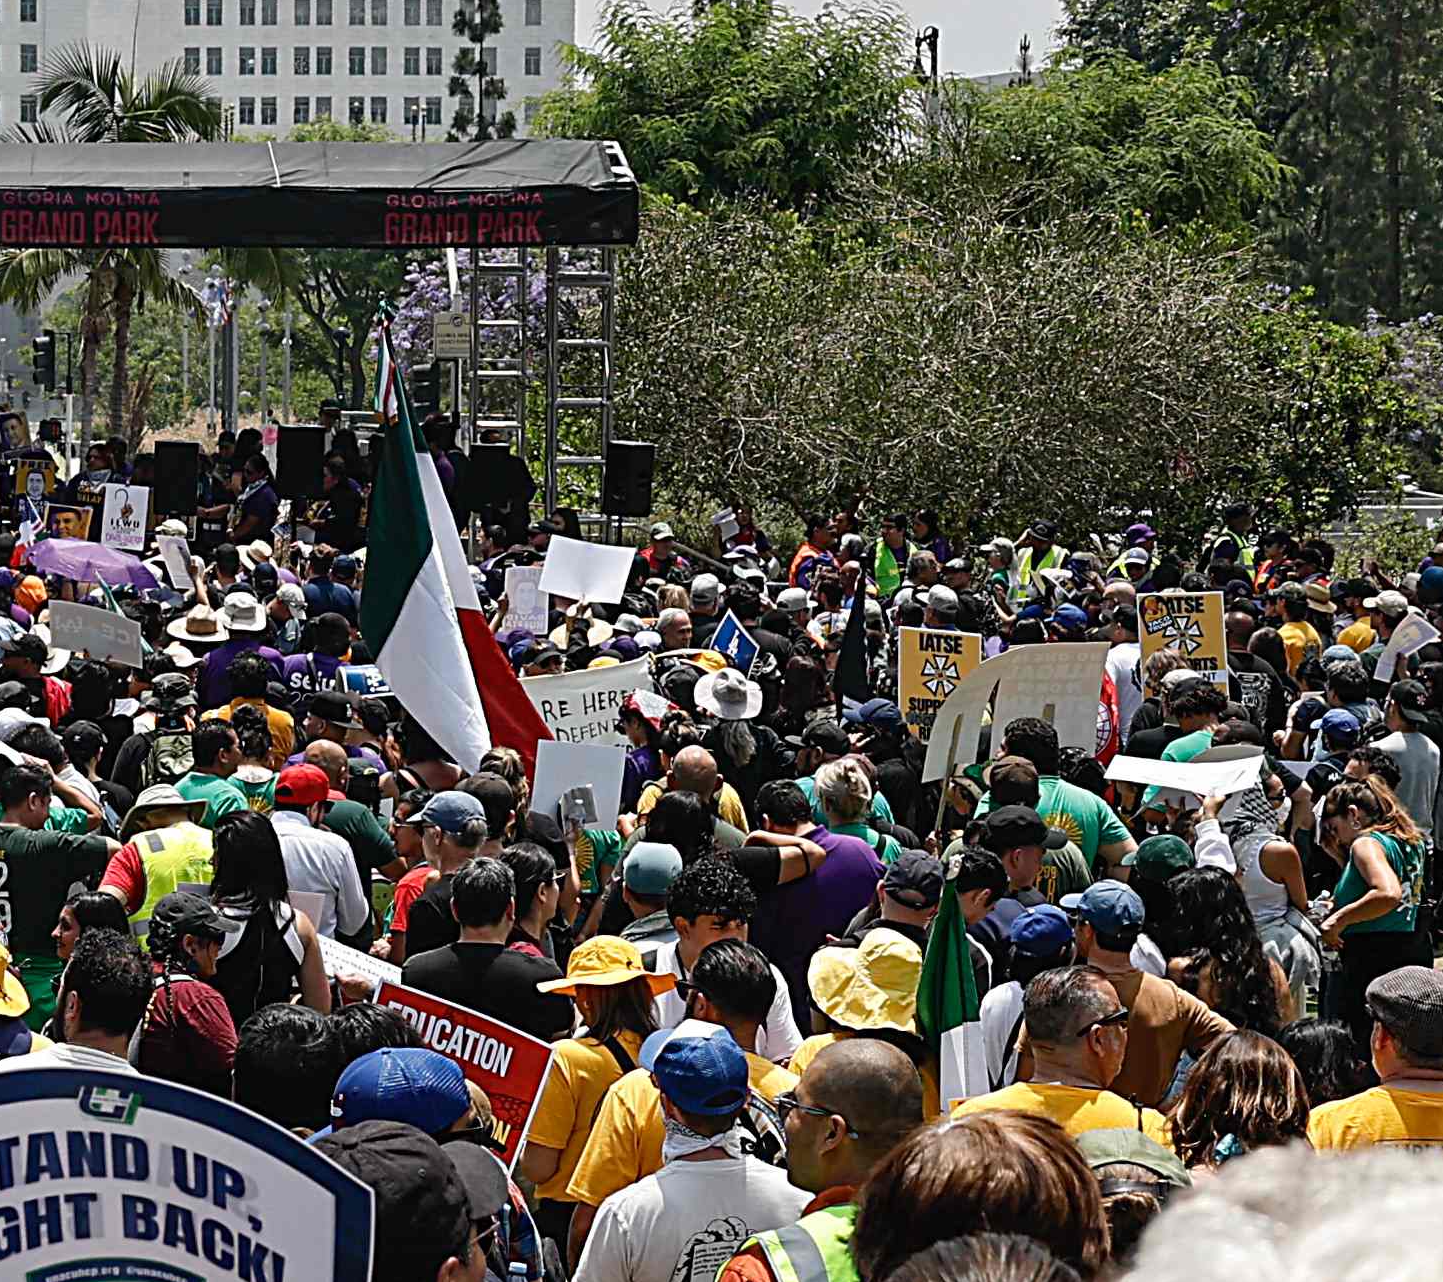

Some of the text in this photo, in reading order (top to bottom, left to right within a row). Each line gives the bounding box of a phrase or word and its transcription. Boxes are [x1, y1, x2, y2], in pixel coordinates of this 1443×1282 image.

[3, 192, 160, 205] GLORIA MOLINA
[386, 192, 544, 208] GLORIA MOLINA
[1, 210, 160, 244] GRAND PARK
[385, 210, 545, 244] GRAND PARK
[919, 633, 962, 654] IATSE
[172, 1146, 264, 1232] UP,
